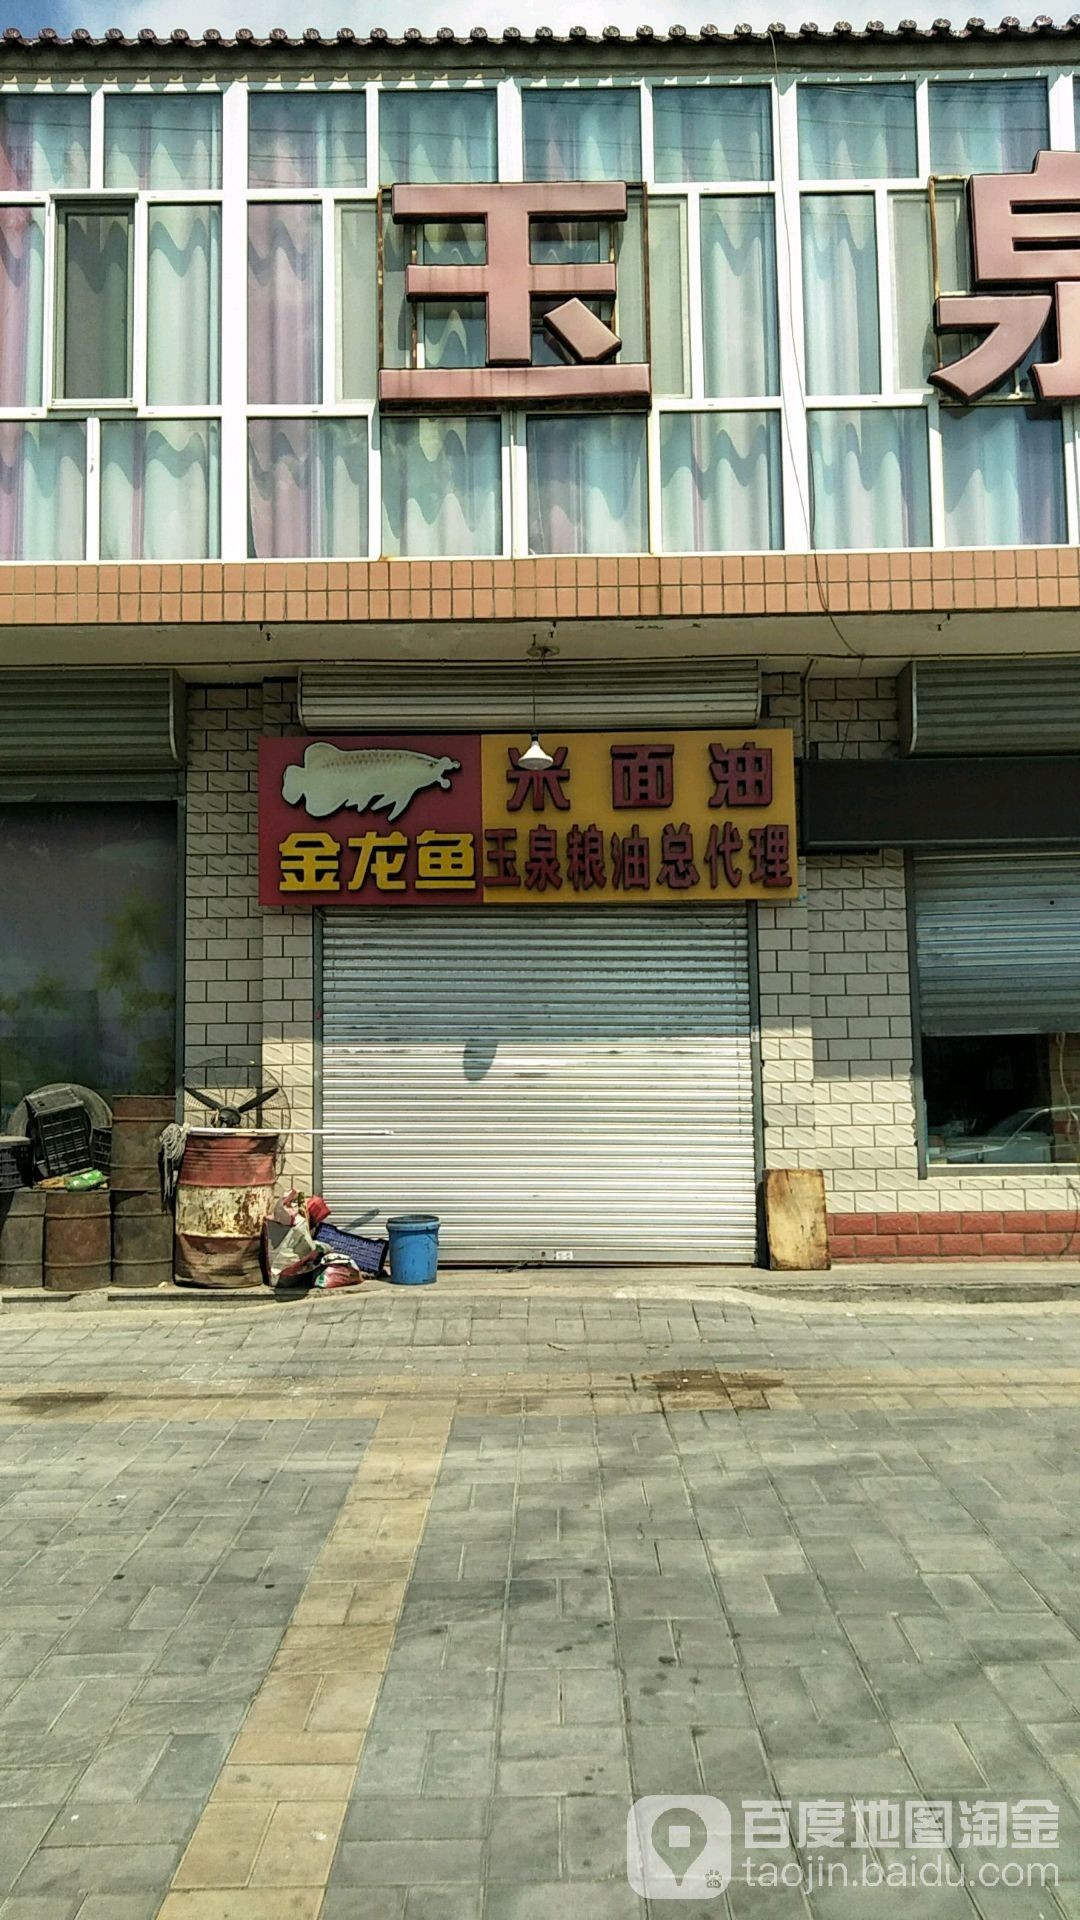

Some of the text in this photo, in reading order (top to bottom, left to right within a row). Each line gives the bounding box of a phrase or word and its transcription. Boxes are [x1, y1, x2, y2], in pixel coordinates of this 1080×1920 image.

[506, 742, 773, 811] 米面油
[279, 830, 476, 891] 金龙鱼
[484, 821, 793, 892] 玉泉粮油总代理
